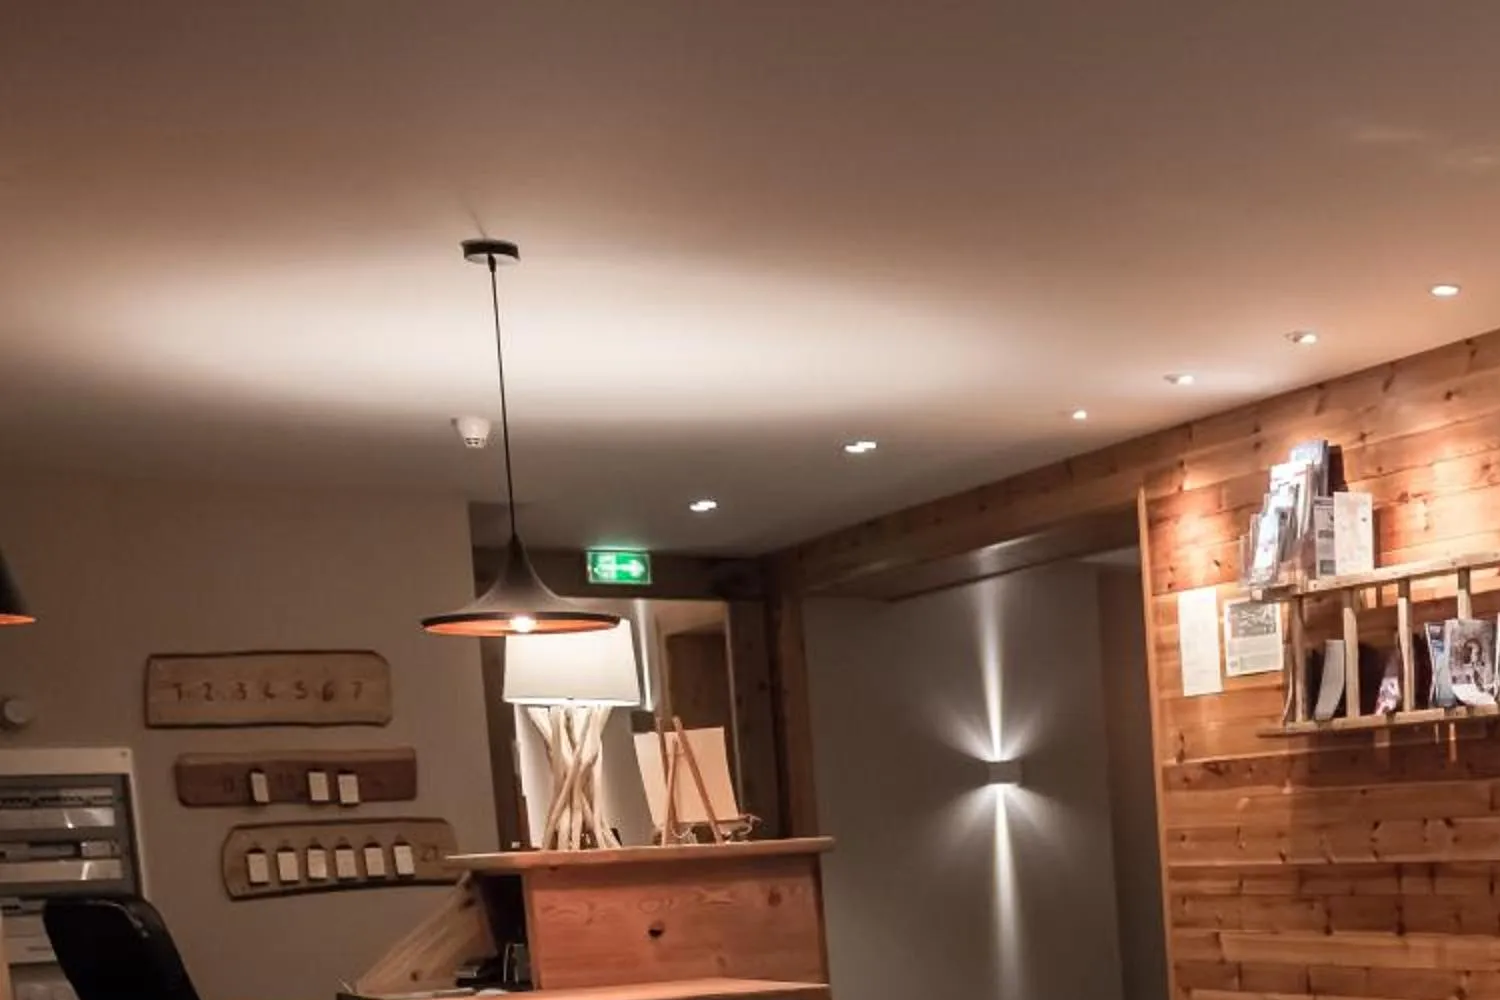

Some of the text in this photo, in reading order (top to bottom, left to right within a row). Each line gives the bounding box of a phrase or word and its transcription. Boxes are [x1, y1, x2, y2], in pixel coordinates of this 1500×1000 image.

[202, 681, 214, 702] 2
[236, 681, 248, 701] 3
[294, 680, 309, 700] 5
[322, 679, 336, 702] 6
[350, 681, 364, 700] 7
